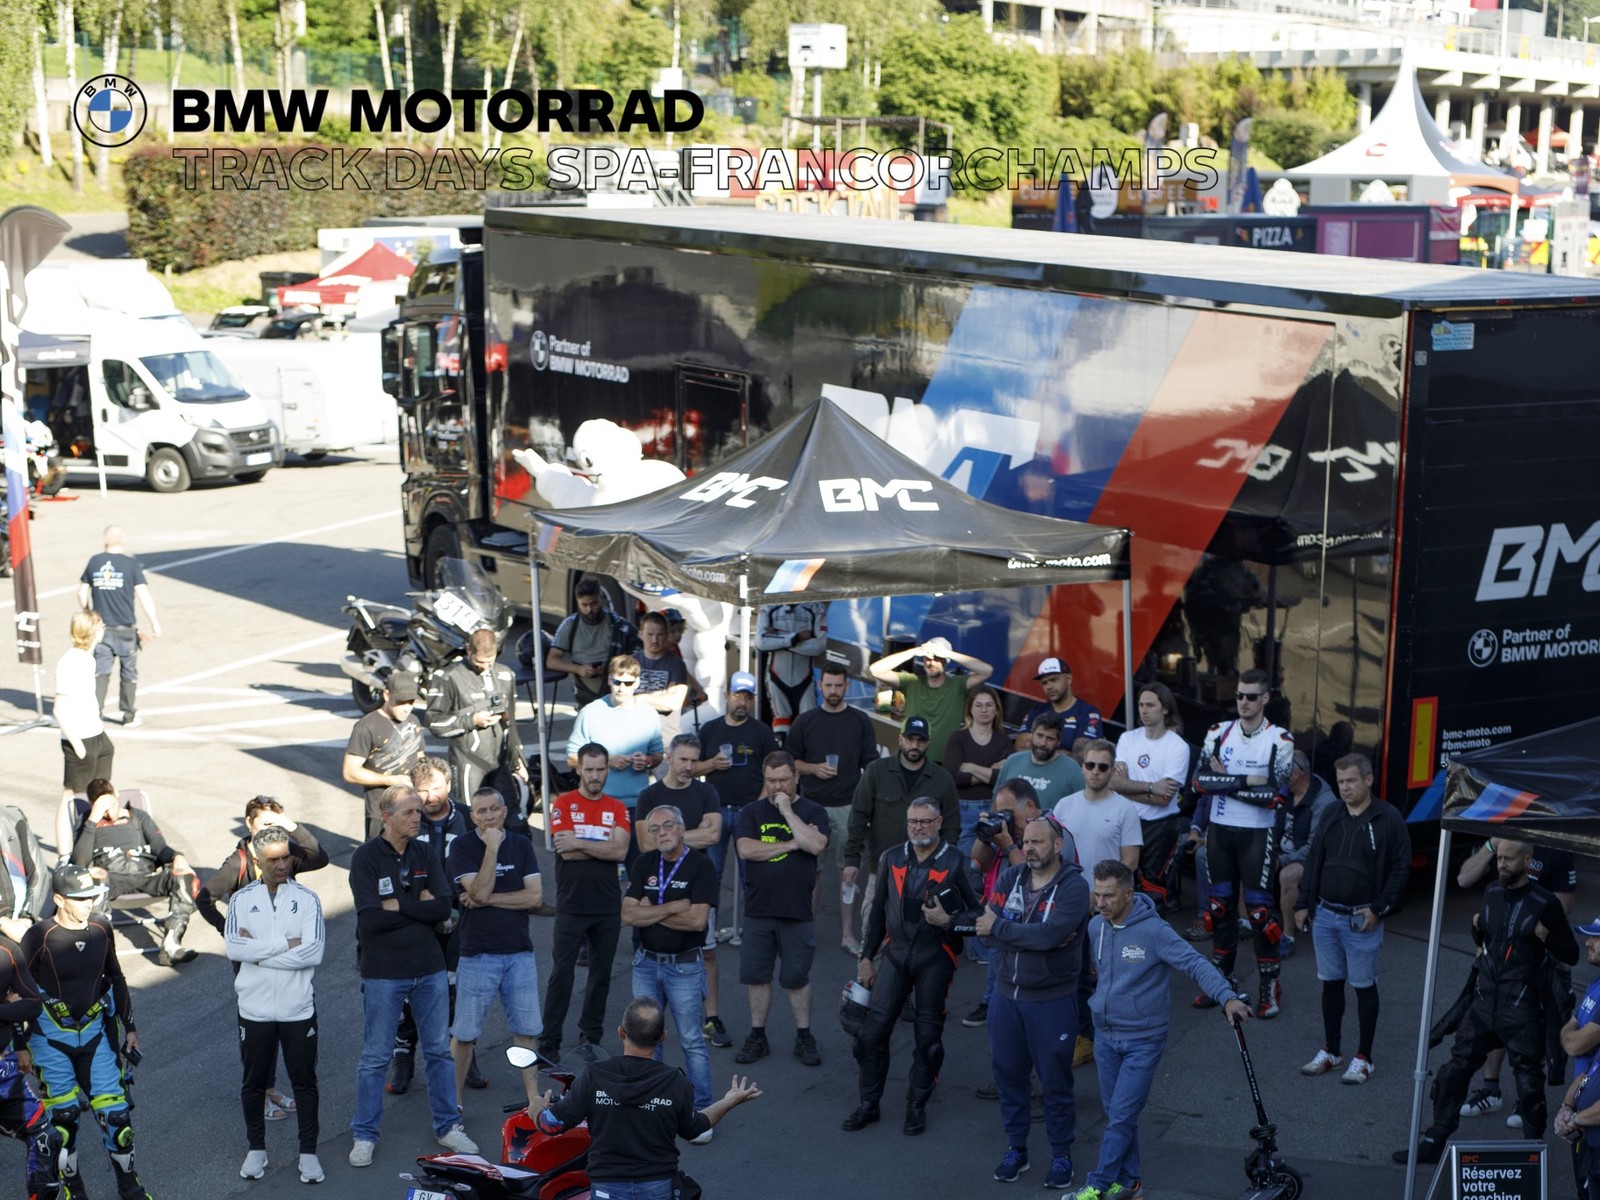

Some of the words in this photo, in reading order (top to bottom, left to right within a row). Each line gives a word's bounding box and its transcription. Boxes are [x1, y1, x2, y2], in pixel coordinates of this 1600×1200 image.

[1252, 226, 1293, 246] PIZZA
[548, 334, 580, 356] Partner
[580, 341, 591, 357] of
[549, 354, 574, 374] BMW
[574, 358, 630, 383] MOTORRAD
[679, 471, 788, 509] BMC
[818, 477, 940, 513] BMC
[1502, 628, 1553, 645] Partner
[1555, 623, 1571, 640] of
[1501, 645, 1541, 663] BMW
[1544, 638, 1600, 659] MOTOR
[1442, 725, 1512, 740] bmc-moto.com
[1442, 738, 1491, 753] #bmcmoto
[596, 1090, 609, 1098] BM
[1462, 1166, 1522, 1180] Réservez
[1462, 1180, 1496, 1193] votre
